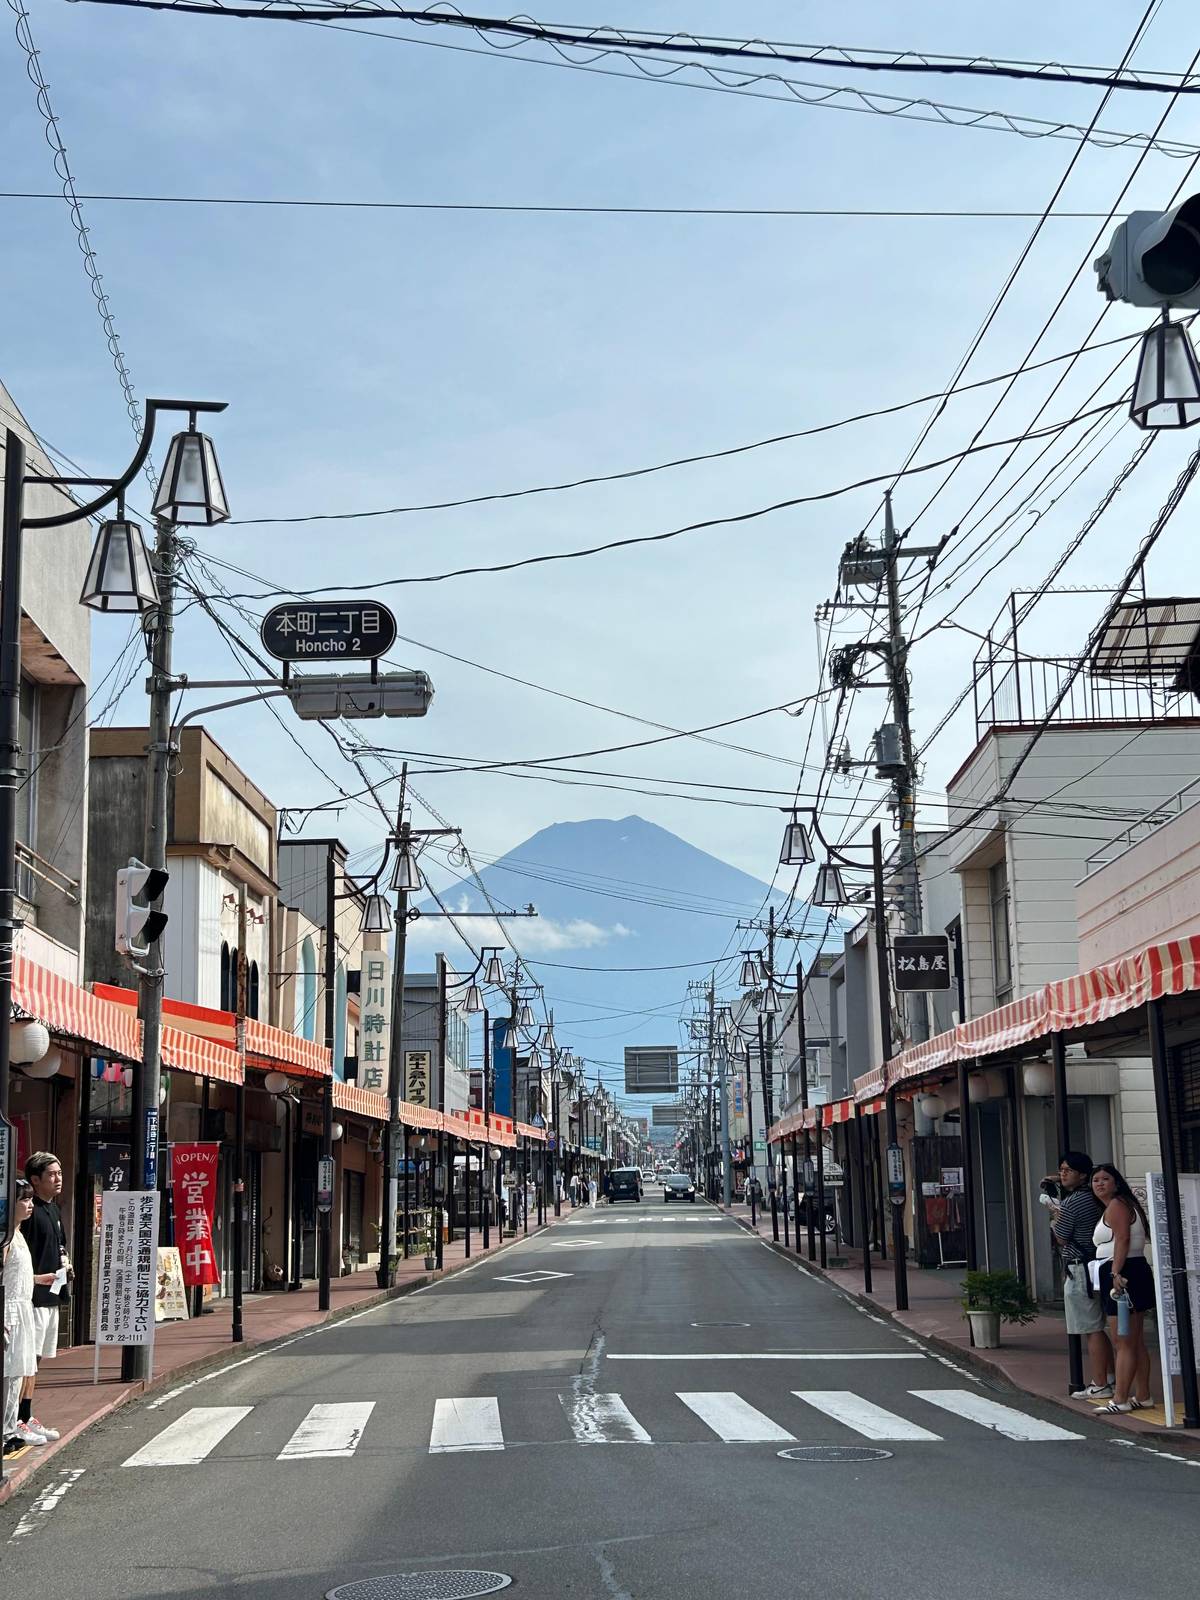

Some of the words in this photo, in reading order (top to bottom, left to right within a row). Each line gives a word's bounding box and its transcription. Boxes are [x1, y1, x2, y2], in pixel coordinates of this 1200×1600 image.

[275, 610, 380, 637] 本町二丁目
[296, 639, 347, 653] Honcho
[352, 637, 361, 651] 2
[897, 954, 947, 971] 松島屋
[363, 960, 386, 1089] 日川時計店
[180, 1152, 210, 1163] OPEN
[181, 1171, 212, 1276] 営業中
[134, 1195, 154, 1332] 歩行者天国交通規制にご協力下さい
